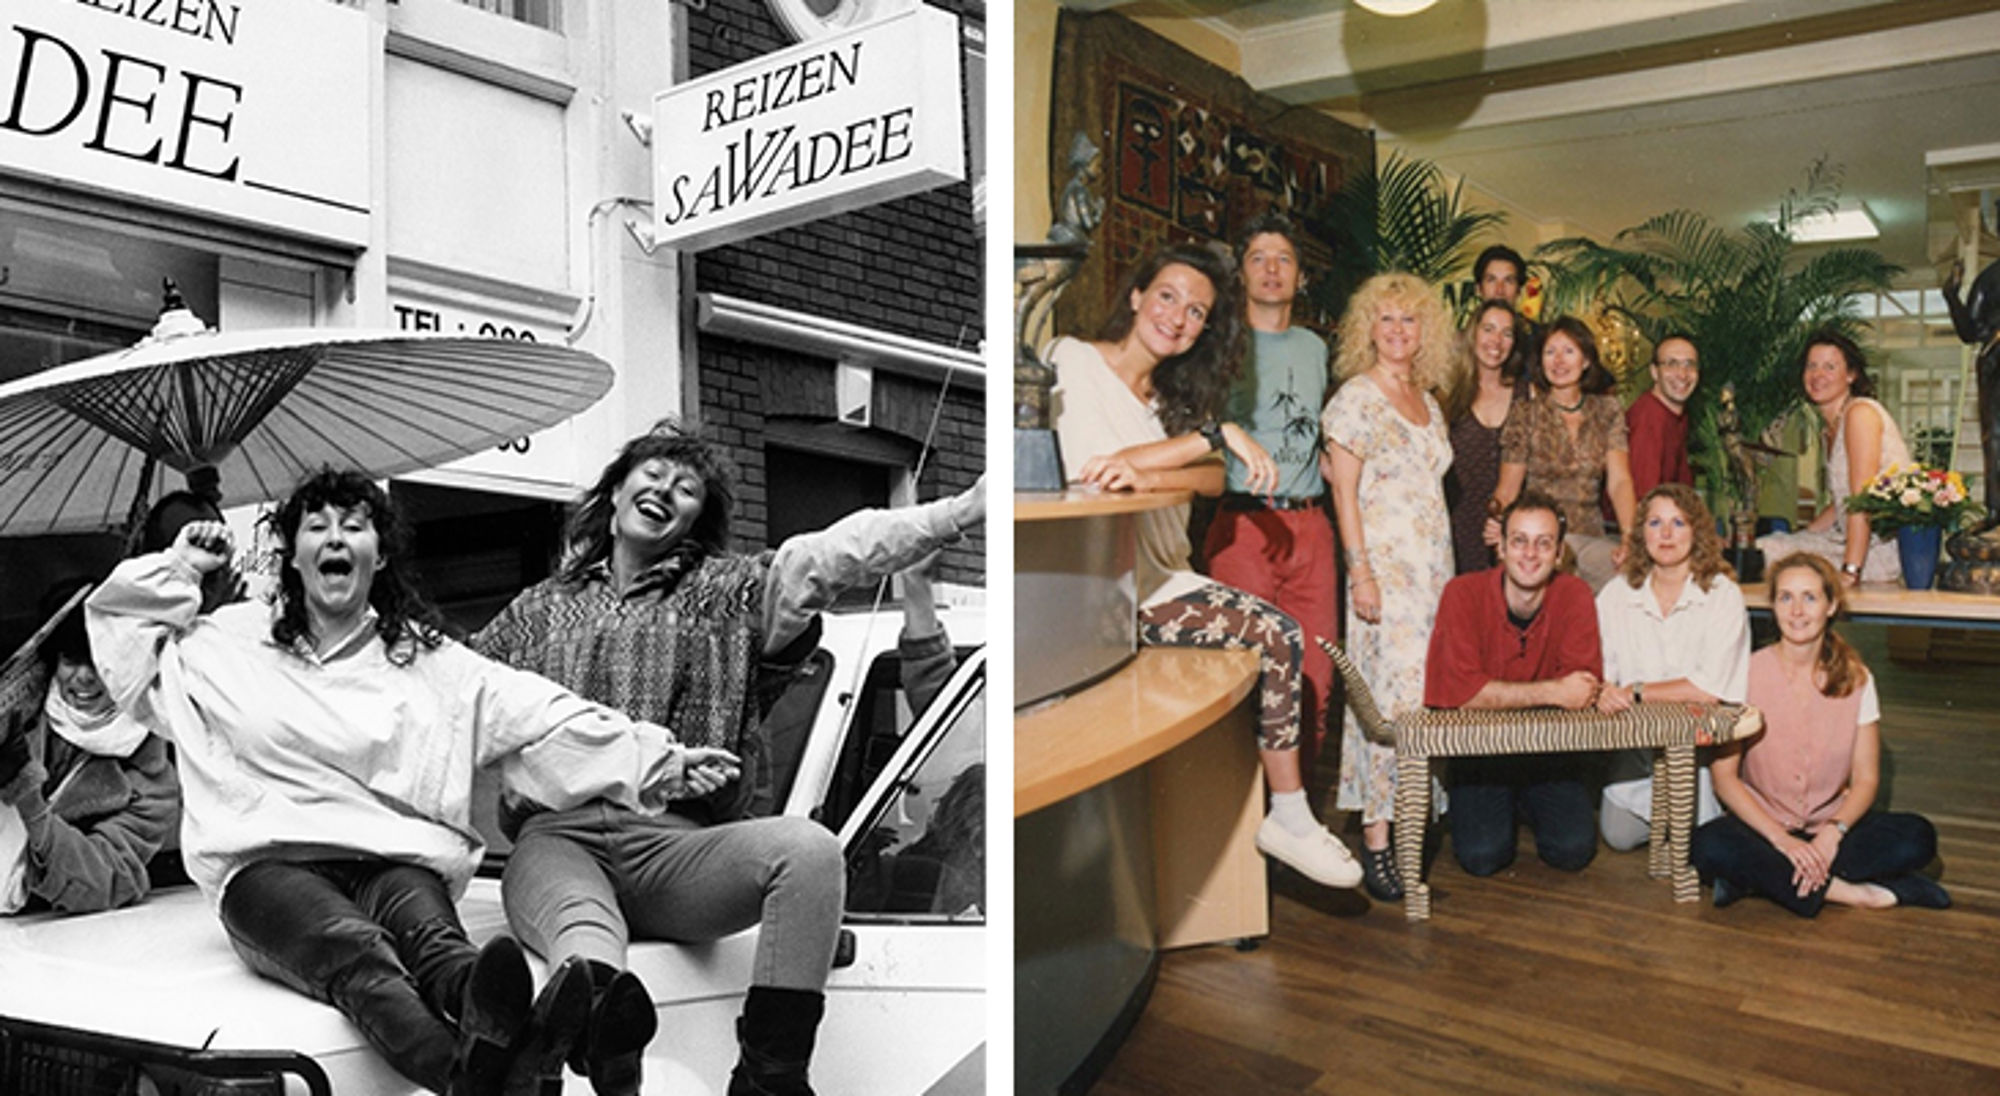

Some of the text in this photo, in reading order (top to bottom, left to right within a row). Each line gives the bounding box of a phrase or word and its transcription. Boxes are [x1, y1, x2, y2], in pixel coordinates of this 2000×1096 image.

[0, 25, 243, 182] DEE
[702, 41, 863, 133] REIZEN
[665, 107, 914, 226] SAWADEE
